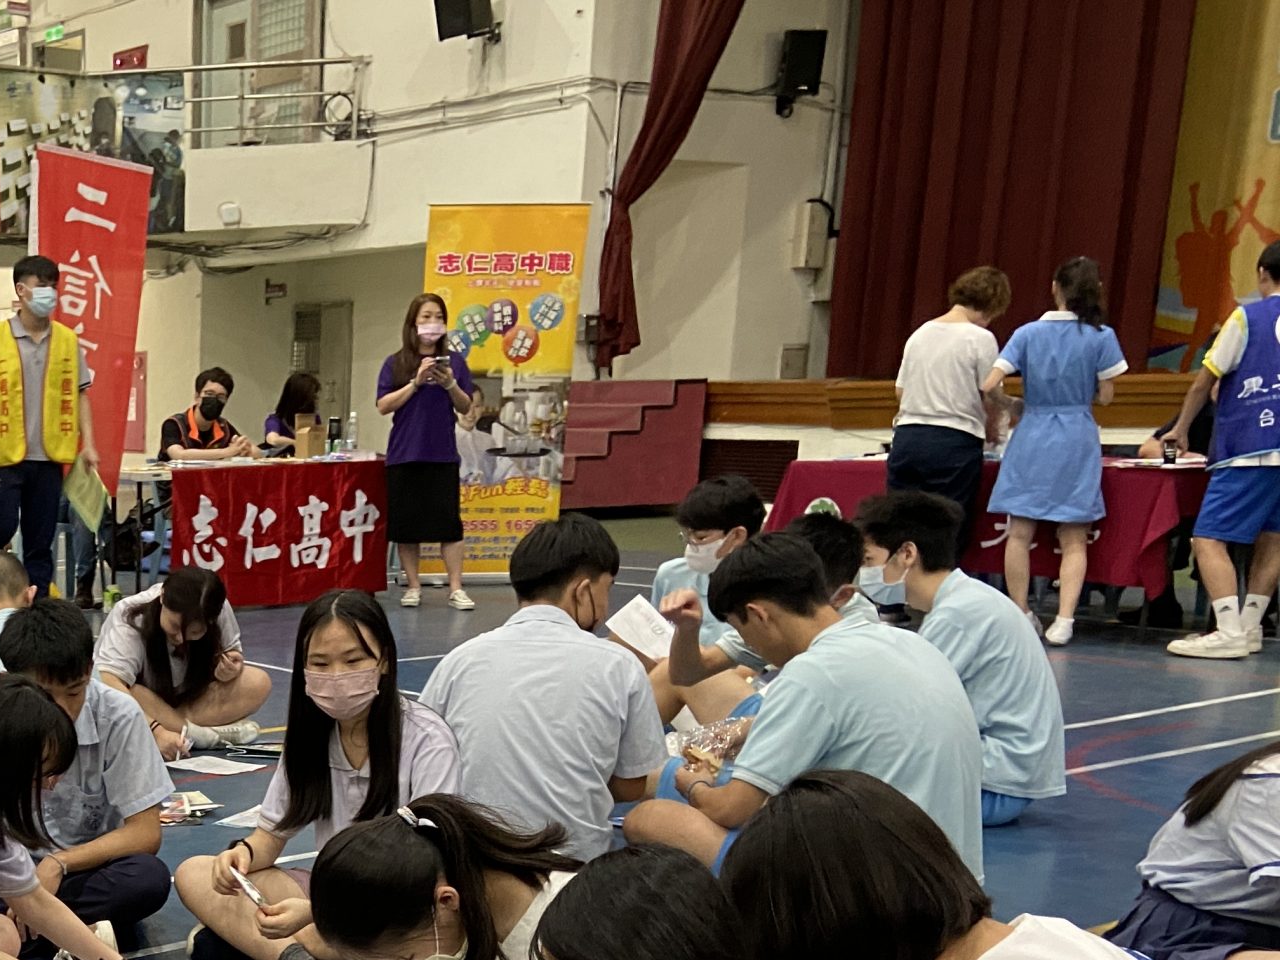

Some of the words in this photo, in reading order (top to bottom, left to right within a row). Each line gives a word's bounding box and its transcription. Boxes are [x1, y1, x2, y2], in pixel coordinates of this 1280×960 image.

[437, 251, 574, 275] 志仁高中職
[182, 489, 380, 571] 志仁高中
